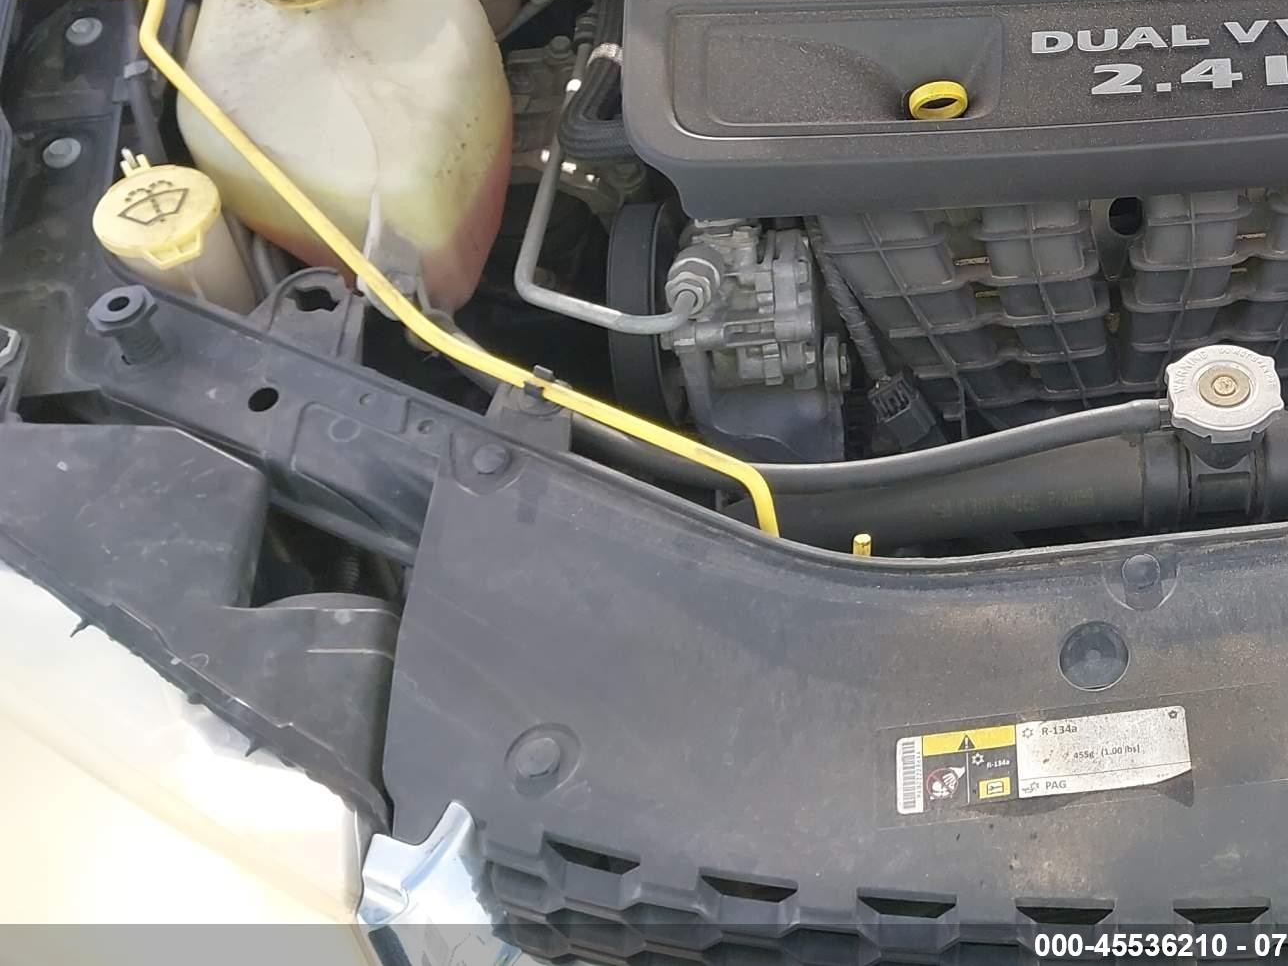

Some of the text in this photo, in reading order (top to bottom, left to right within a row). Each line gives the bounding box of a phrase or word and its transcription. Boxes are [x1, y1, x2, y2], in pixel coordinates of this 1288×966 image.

[1031, 24, 1210, 54] DUAL
[1173, 351, 1208, 394] WARNING
[1041, 724, 1078, 735] R-134a
[1100, 745, 1123, 758] (1.00
[1045, 779, 1067, 790] PAG
